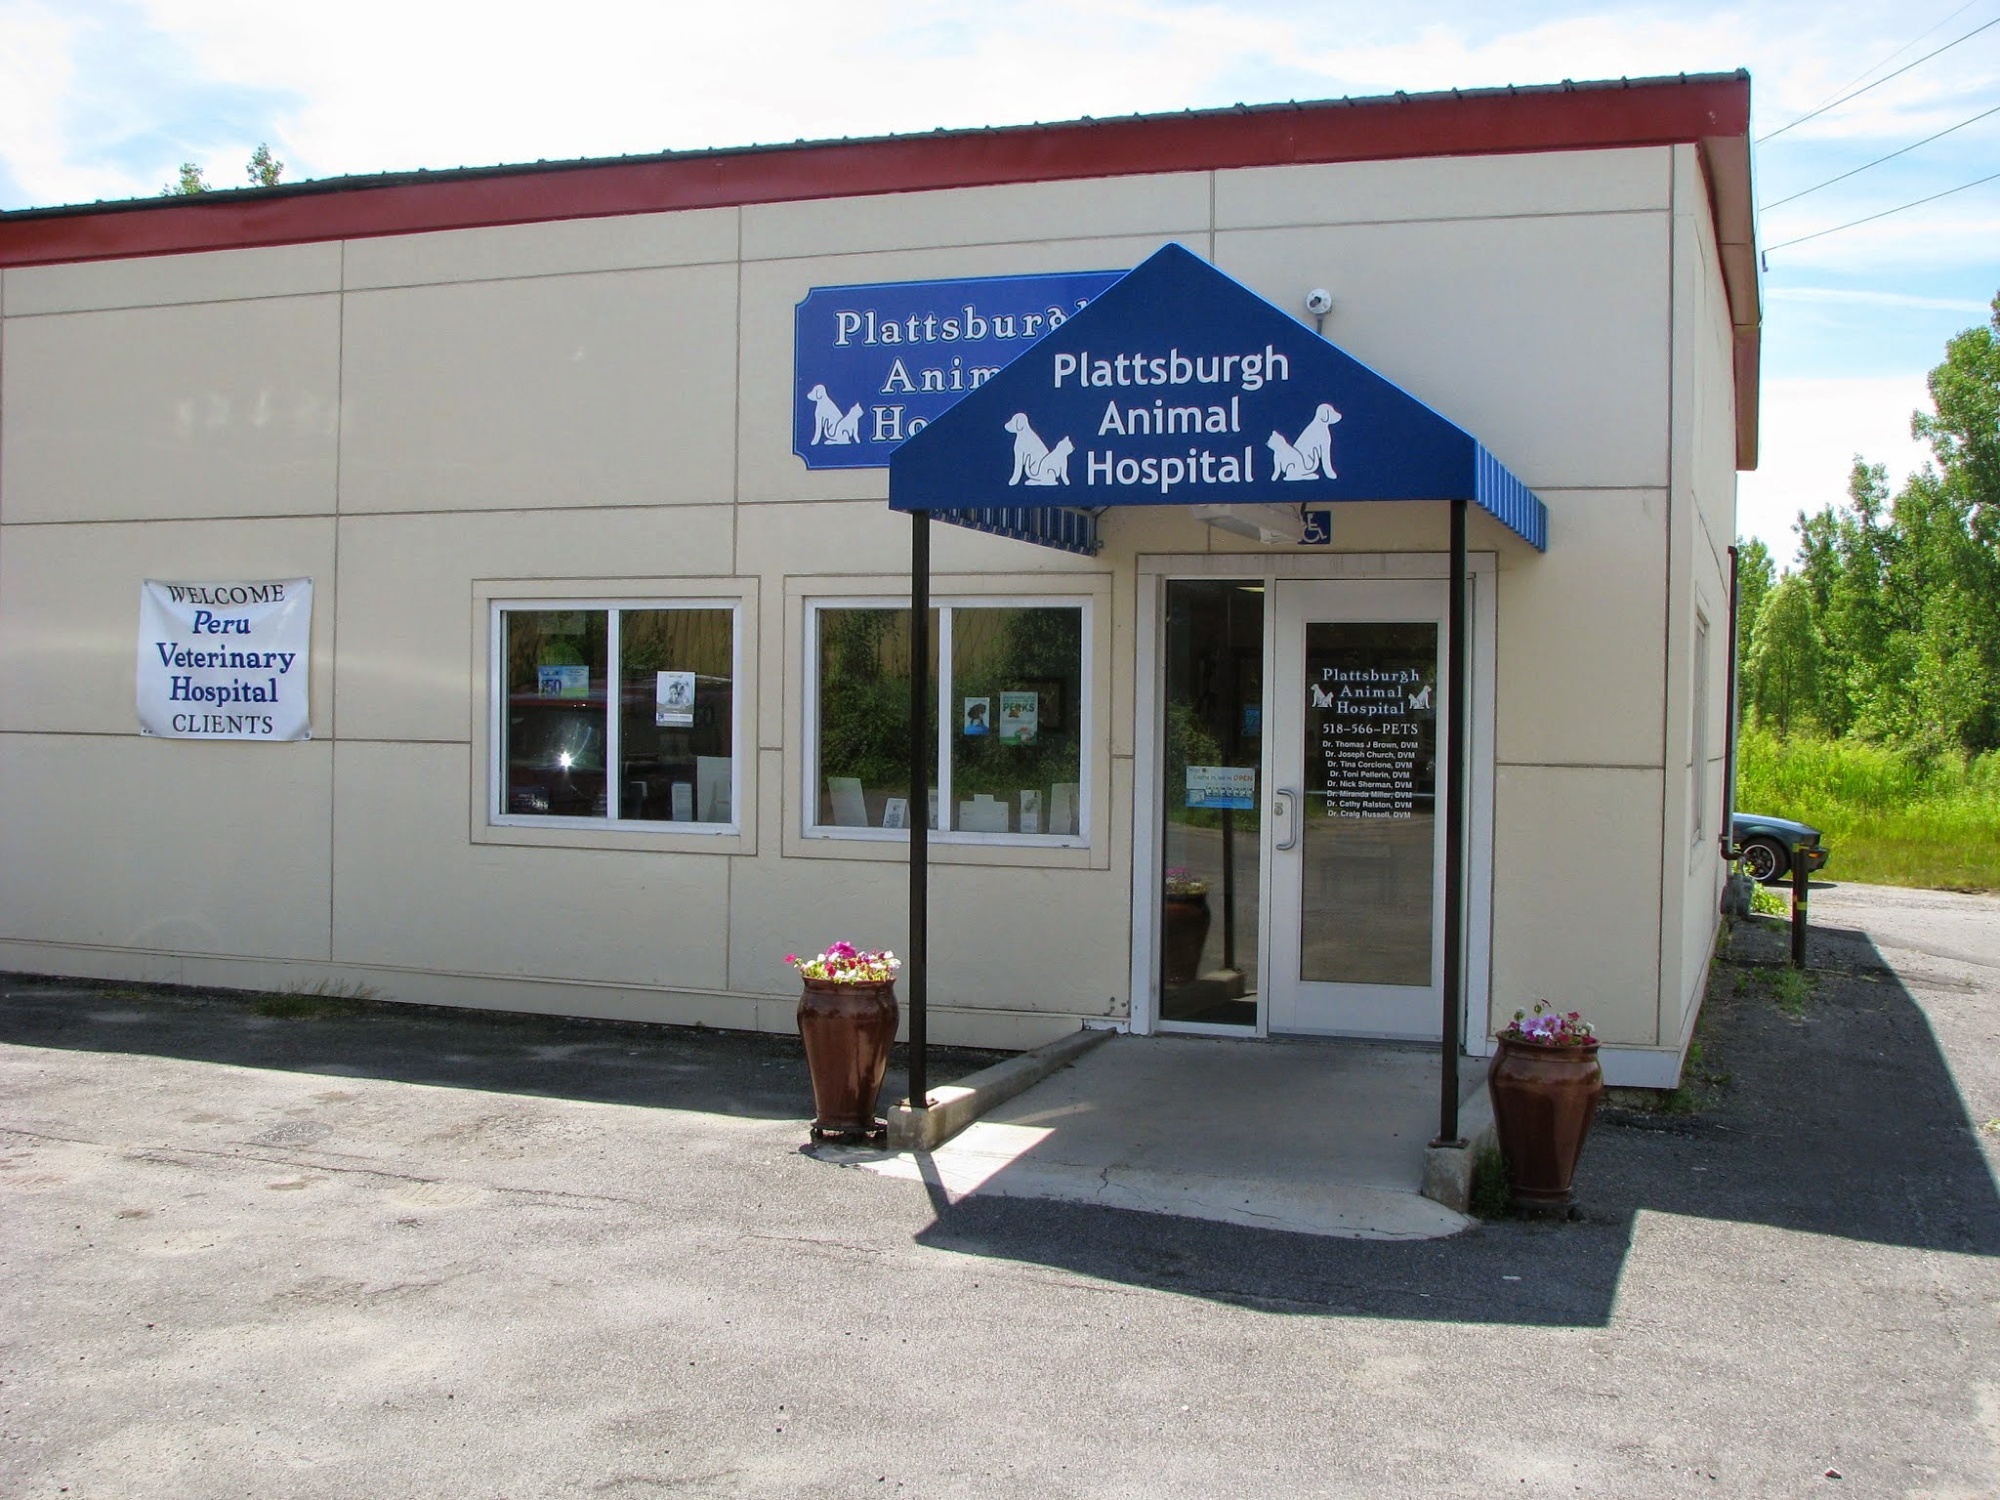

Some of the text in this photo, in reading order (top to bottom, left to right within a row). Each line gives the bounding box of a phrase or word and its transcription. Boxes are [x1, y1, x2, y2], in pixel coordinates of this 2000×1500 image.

[1054, 344, 1288, 391] Plattsburgh
[1098, 396, 1240, 435] Animal
[1087, 446, 1254, 493] Hospital
[167, 584, 285, 604] WELCOME
[192, 610, 251, 634] Peru
[156, 642, 296, 674] Veterinary
[1323, 668, 1419, 683] Plattsburgh
[169, 676, 278, 707] Hospital
[1340, 685, 1402, 698] Animal
[1337, 701, 1405, 716] Hospital
[173, 714, 273, 734] CLIENTS
[1323, 723, 1418, 735] 518-566-PETS
[1338, 751, 1364, 759] Joseph
[1367, 751, 1395, 759] Church,
[1358, 781, 1393, 789] Sherman,
[1339, 800, 1360, 808] Cathy
[1363, 801, 1393, 809] Ralston,
